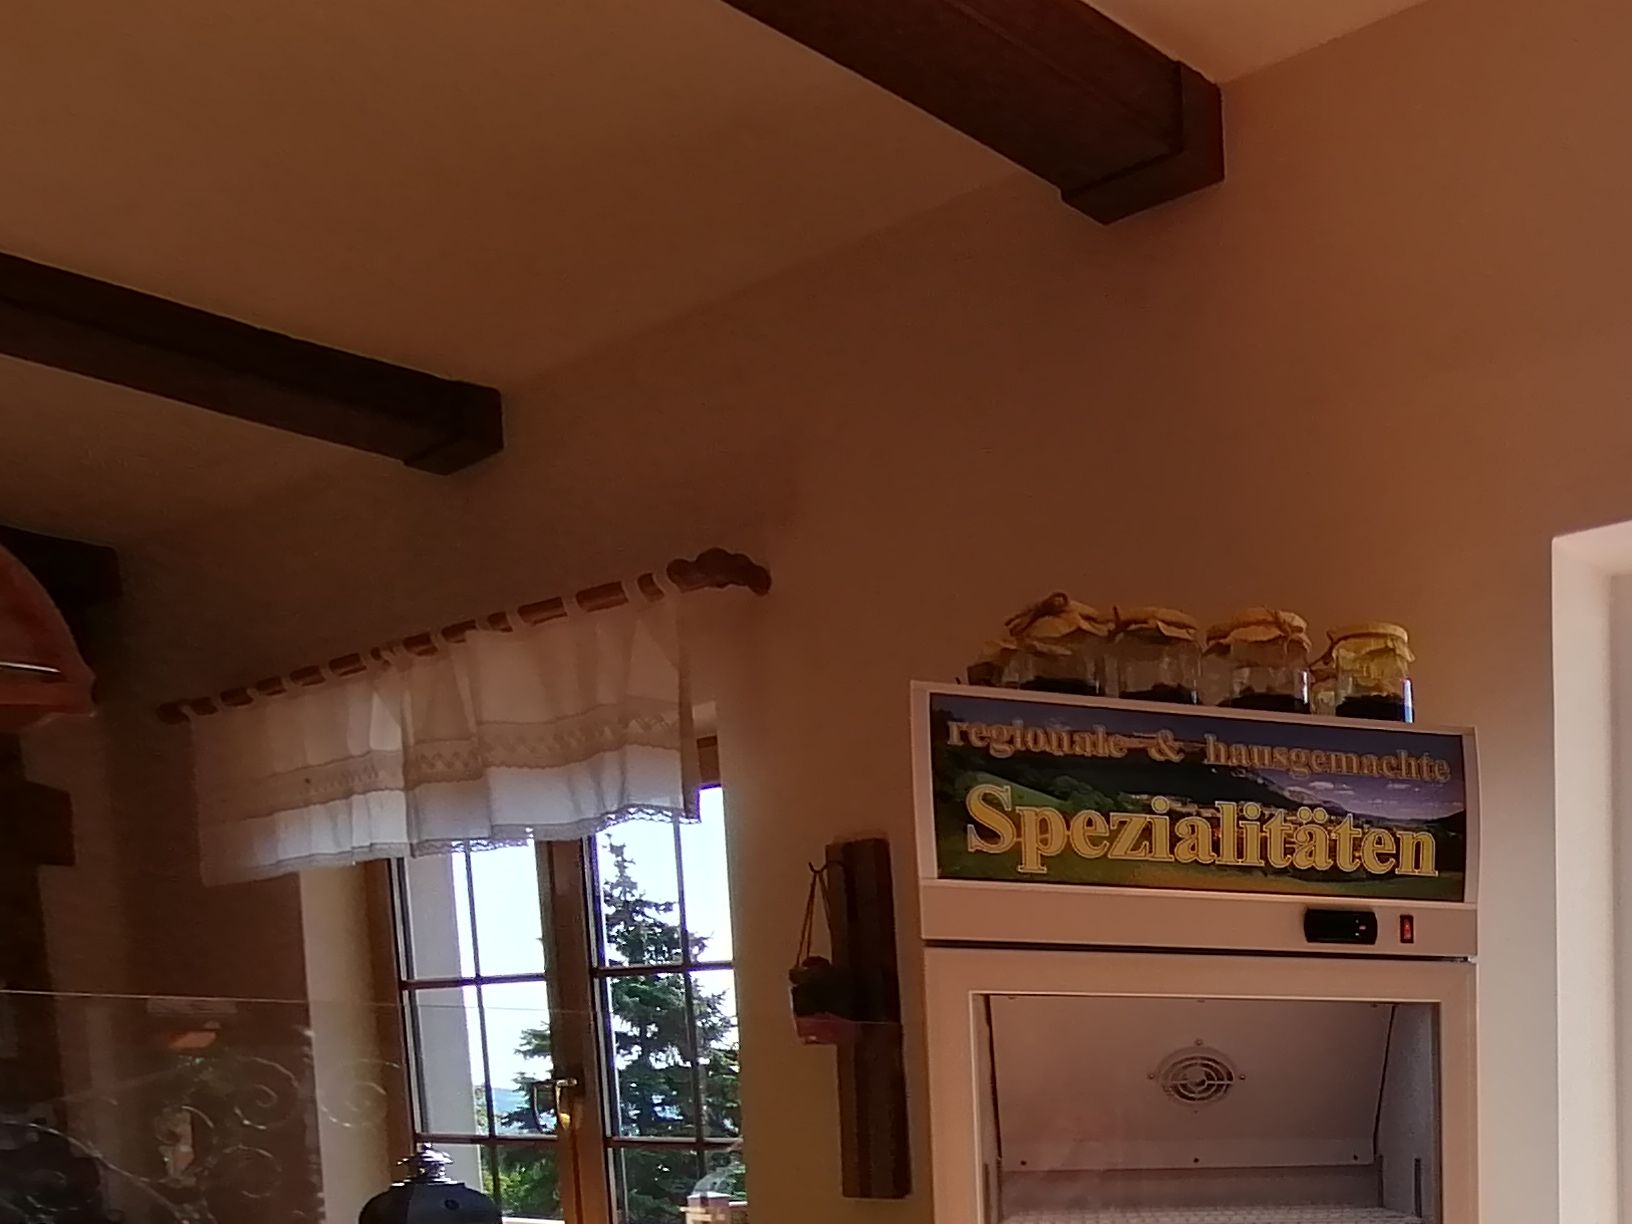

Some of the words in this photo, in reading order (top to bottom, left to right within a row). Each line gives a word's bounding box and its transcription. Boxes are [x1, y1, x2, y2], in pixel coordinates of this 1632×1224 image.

[947, 716, 1128, 758] regionale
[1147, 731, 1185, 763] &
[1204, 733, 1452, 783] hausgemachte
[966, 783, 1439, 878] Spezialitäten
